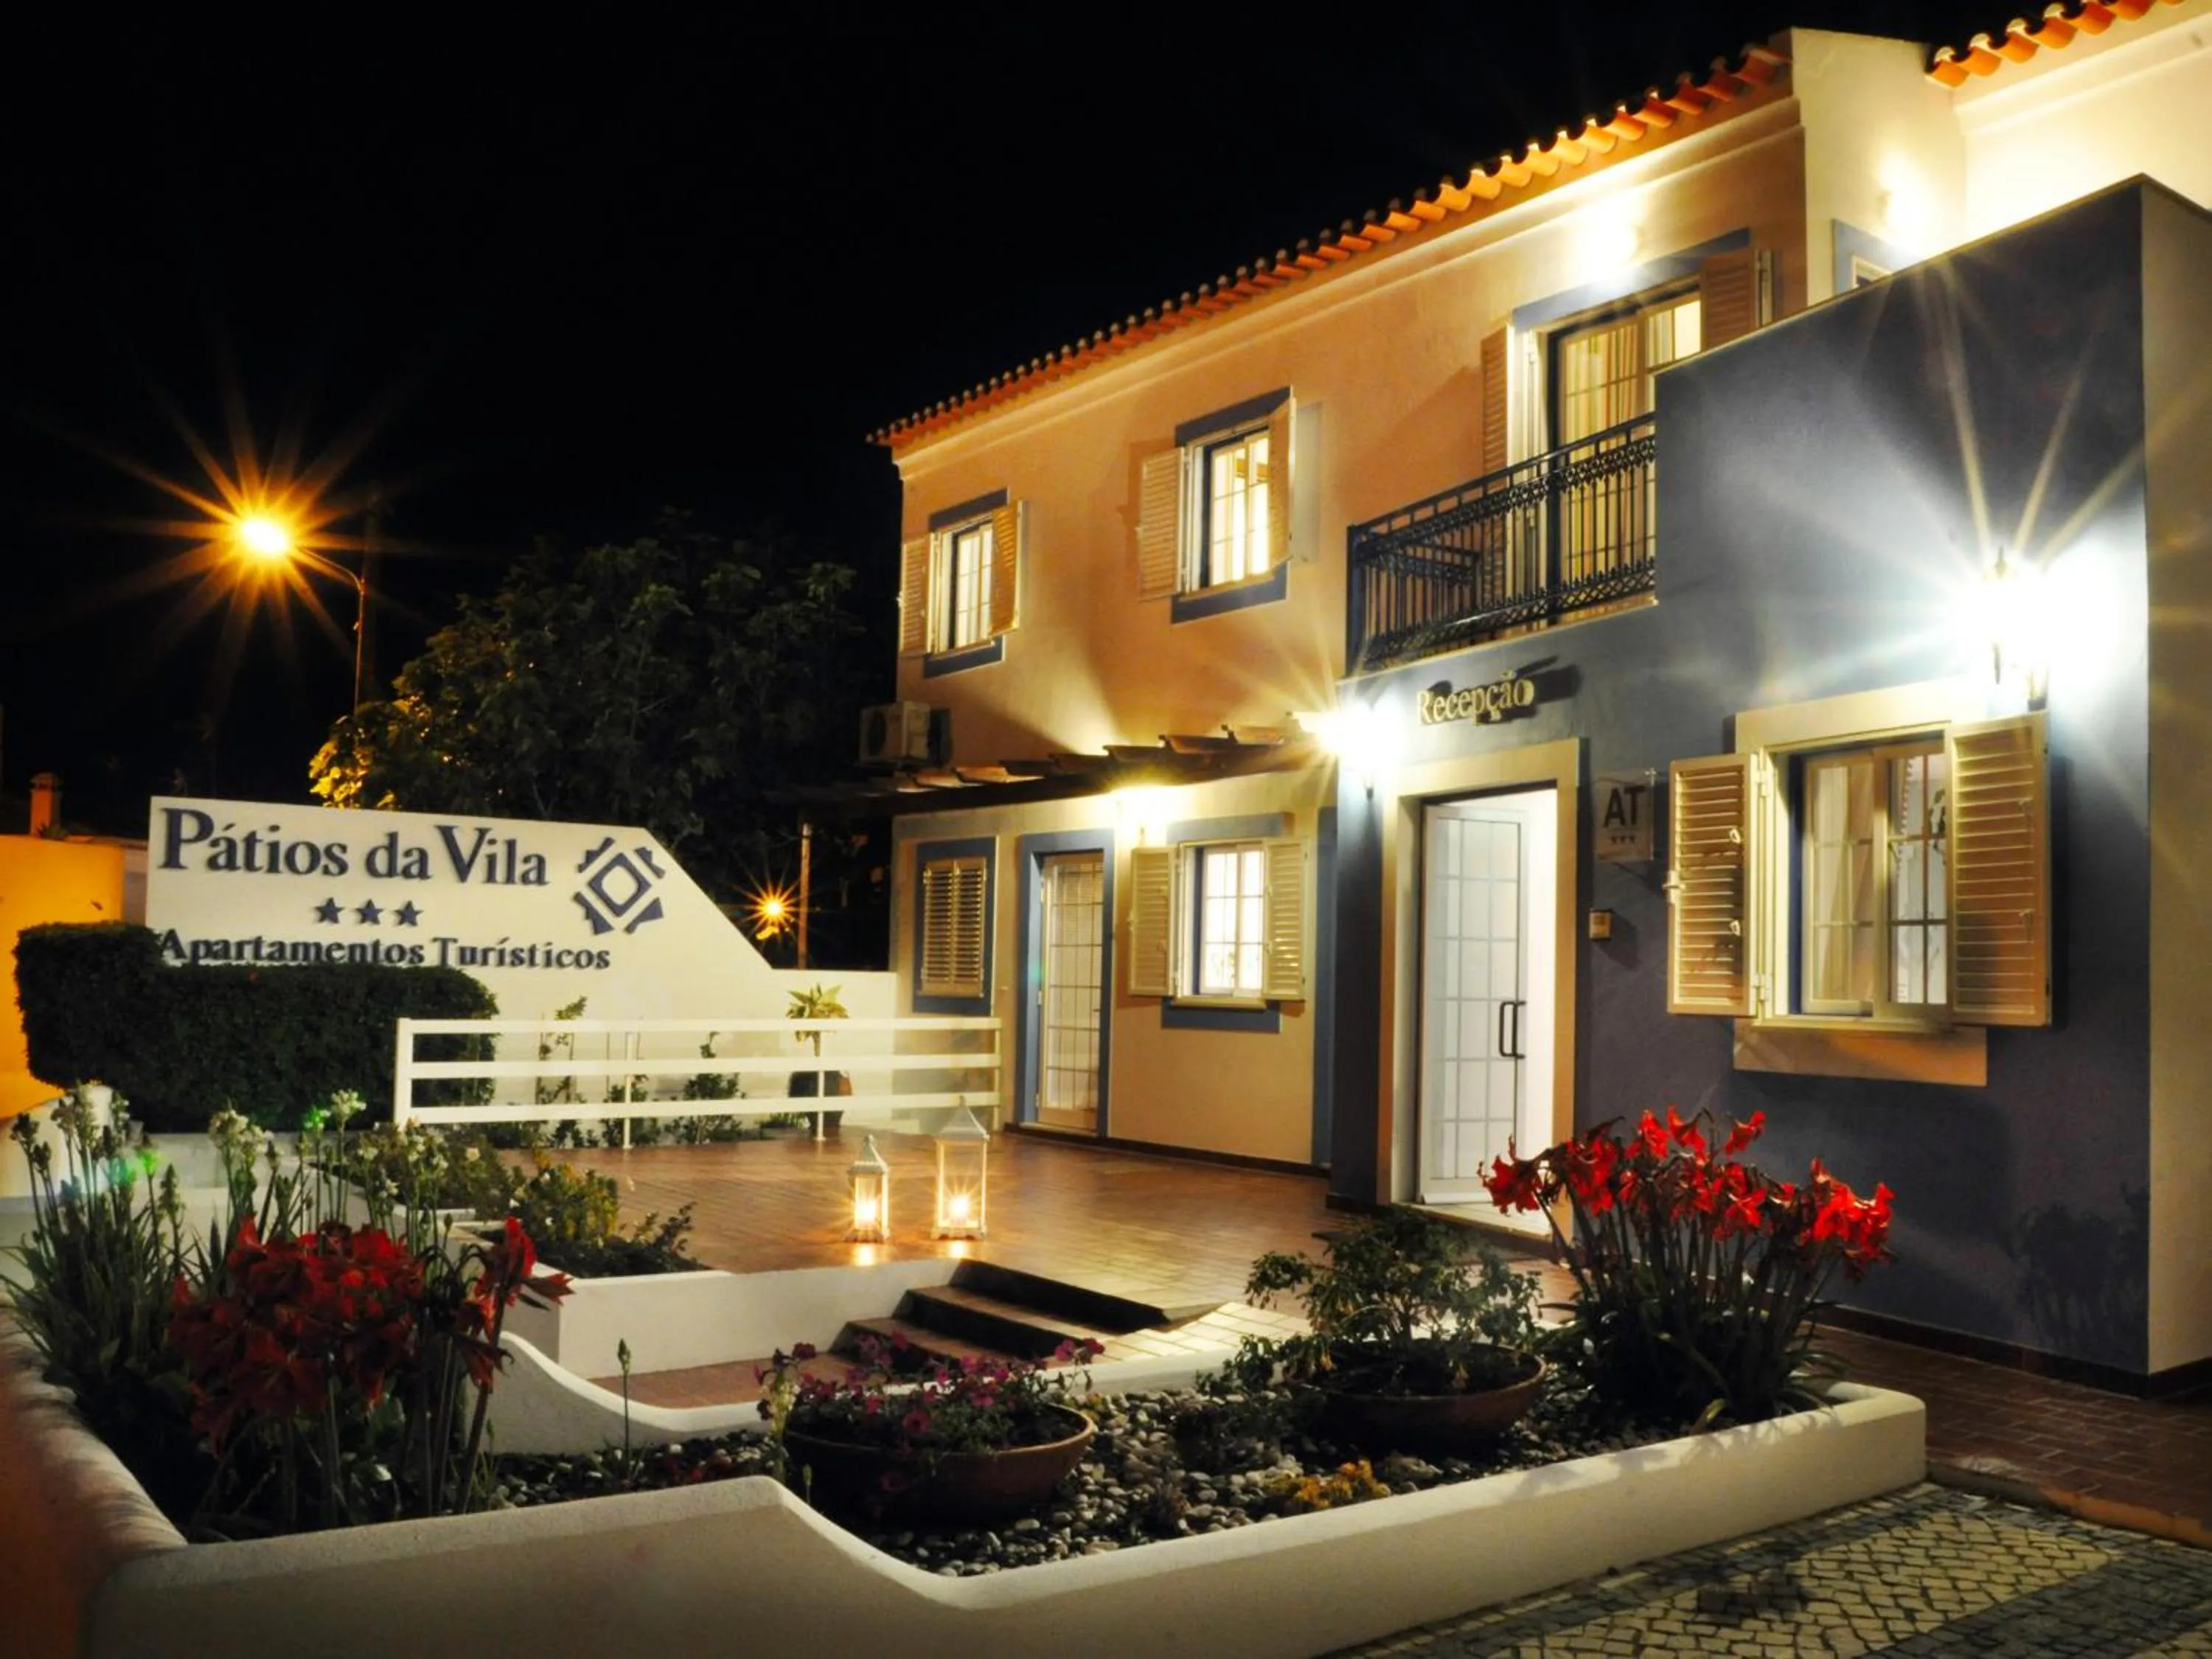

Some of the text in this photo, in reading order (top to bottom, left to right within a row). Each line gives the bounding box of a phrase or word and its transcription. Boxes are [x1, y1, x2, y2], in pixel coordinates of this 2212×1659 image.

[1416, 669, 1534, 726] Recepção
[1602, 786, 1646, 828] AT
[158, 807, 549, 886] Pátios da Vila
[161, 928, 611, 969] Apartamentos Turísticos
